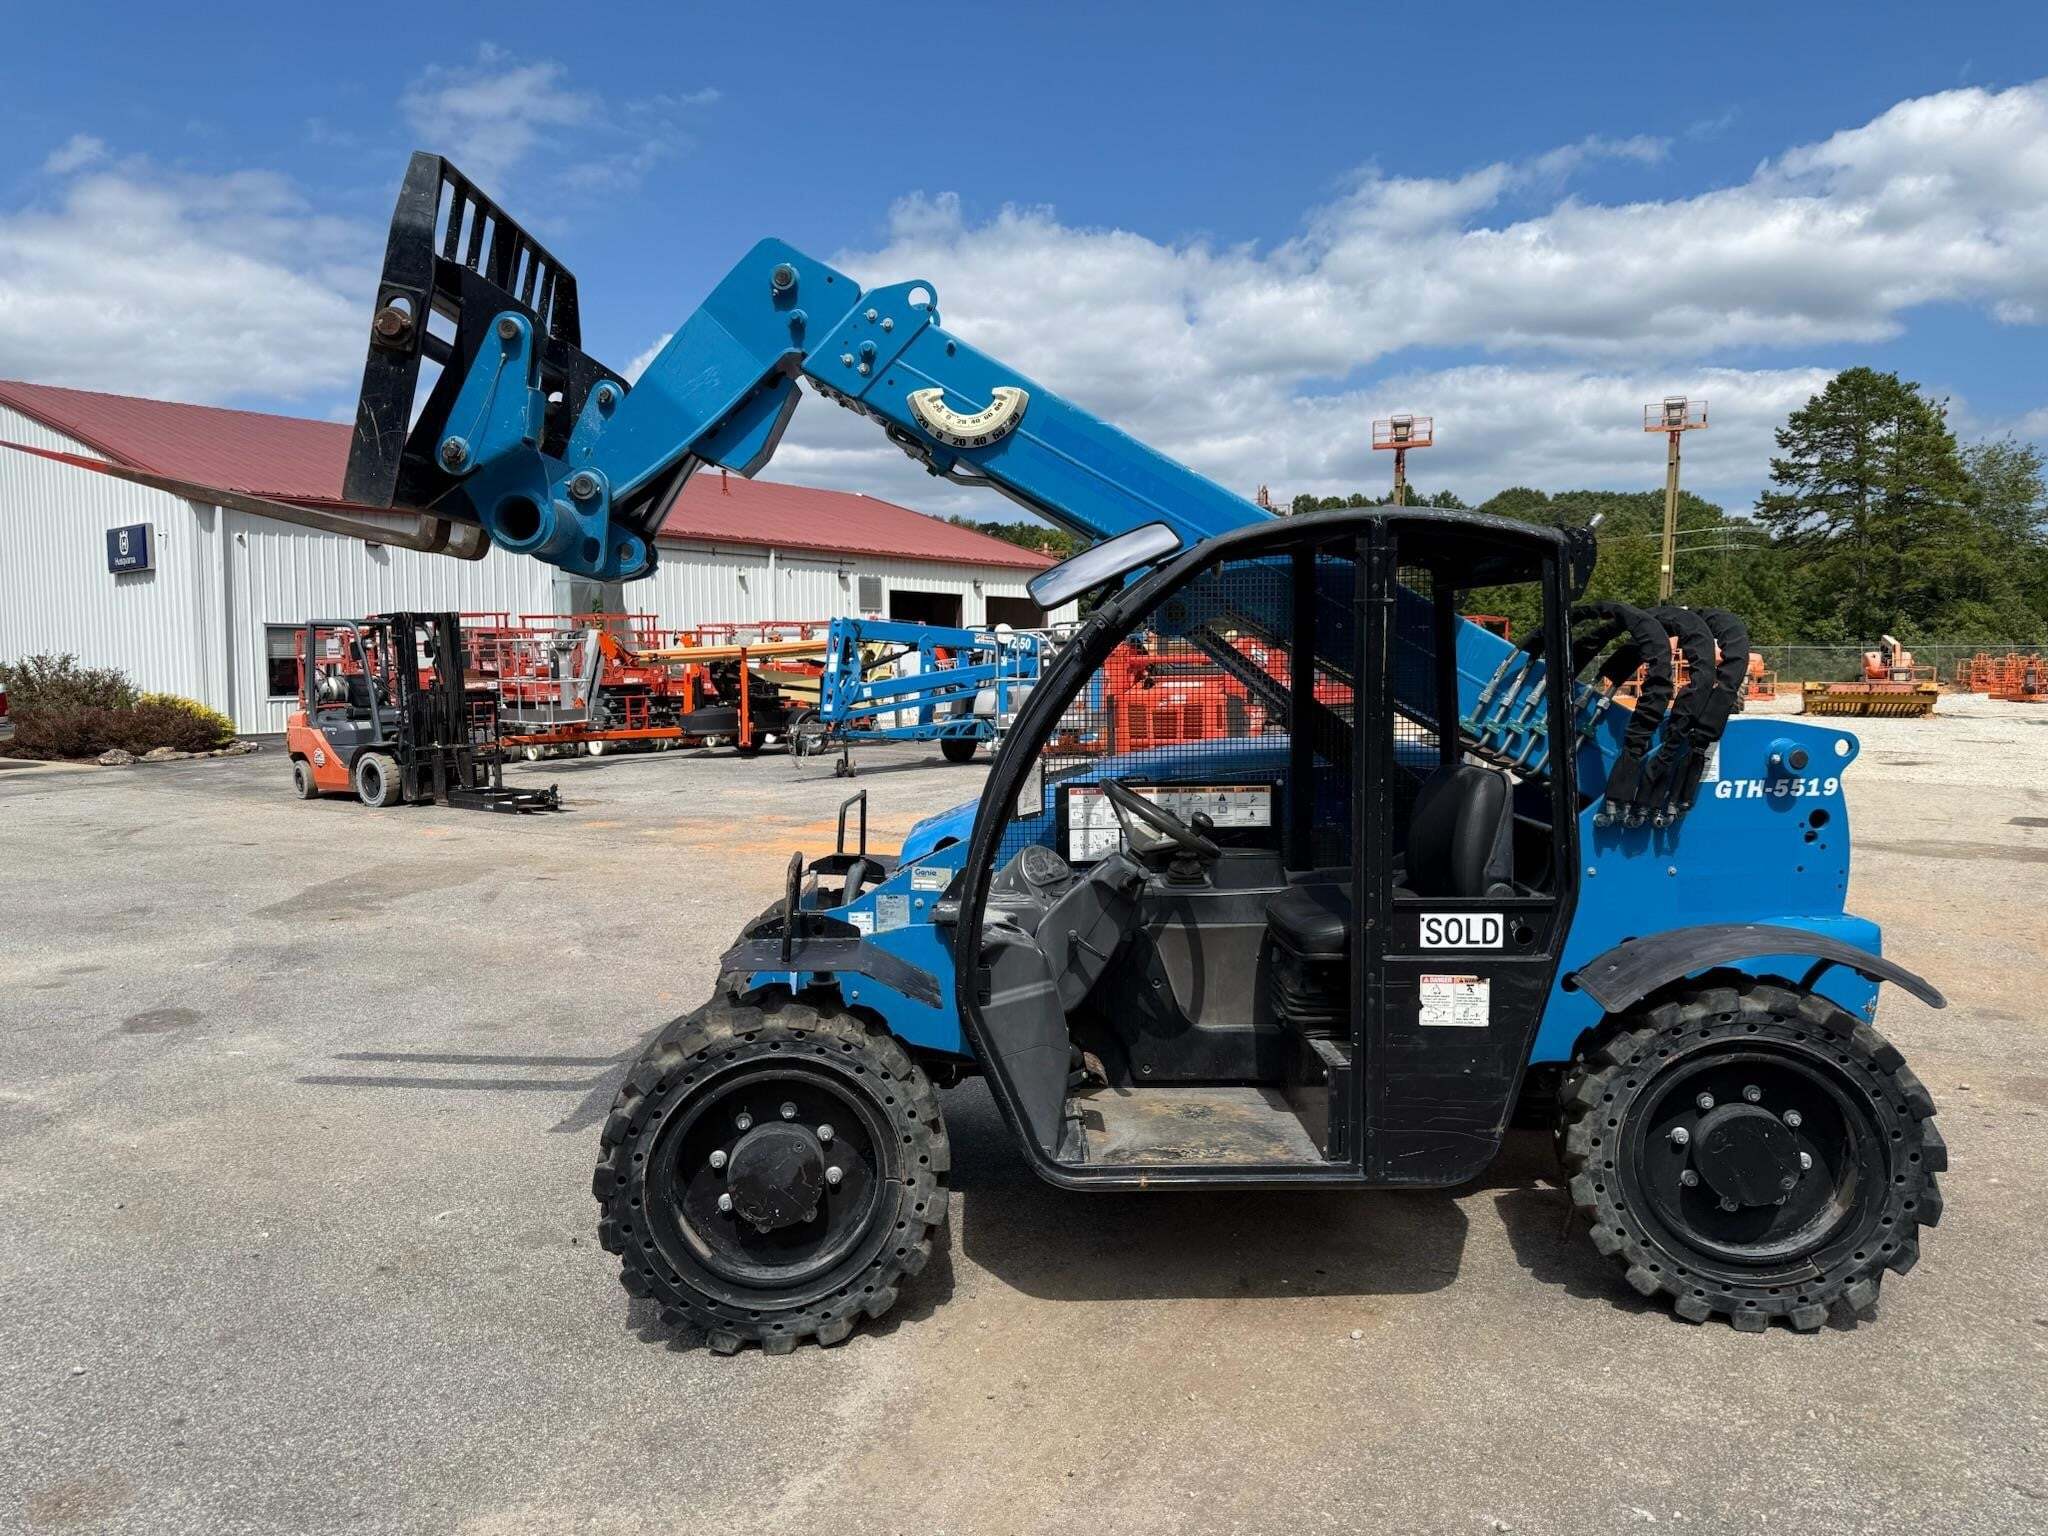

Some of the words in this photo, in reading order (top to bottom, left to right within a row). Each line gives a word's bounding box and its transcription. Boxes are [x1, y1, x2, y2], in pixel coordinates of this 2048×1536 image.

[936, 431, 943, 440] 0
[952, 437, 966, 447] 20
[973, 436, 987, 446] 40
[1715, 777, 1839, 799] GTH-5519
[914, 868, 937, 877] Genie
[1425, 917, 1500, 945] SOLD
